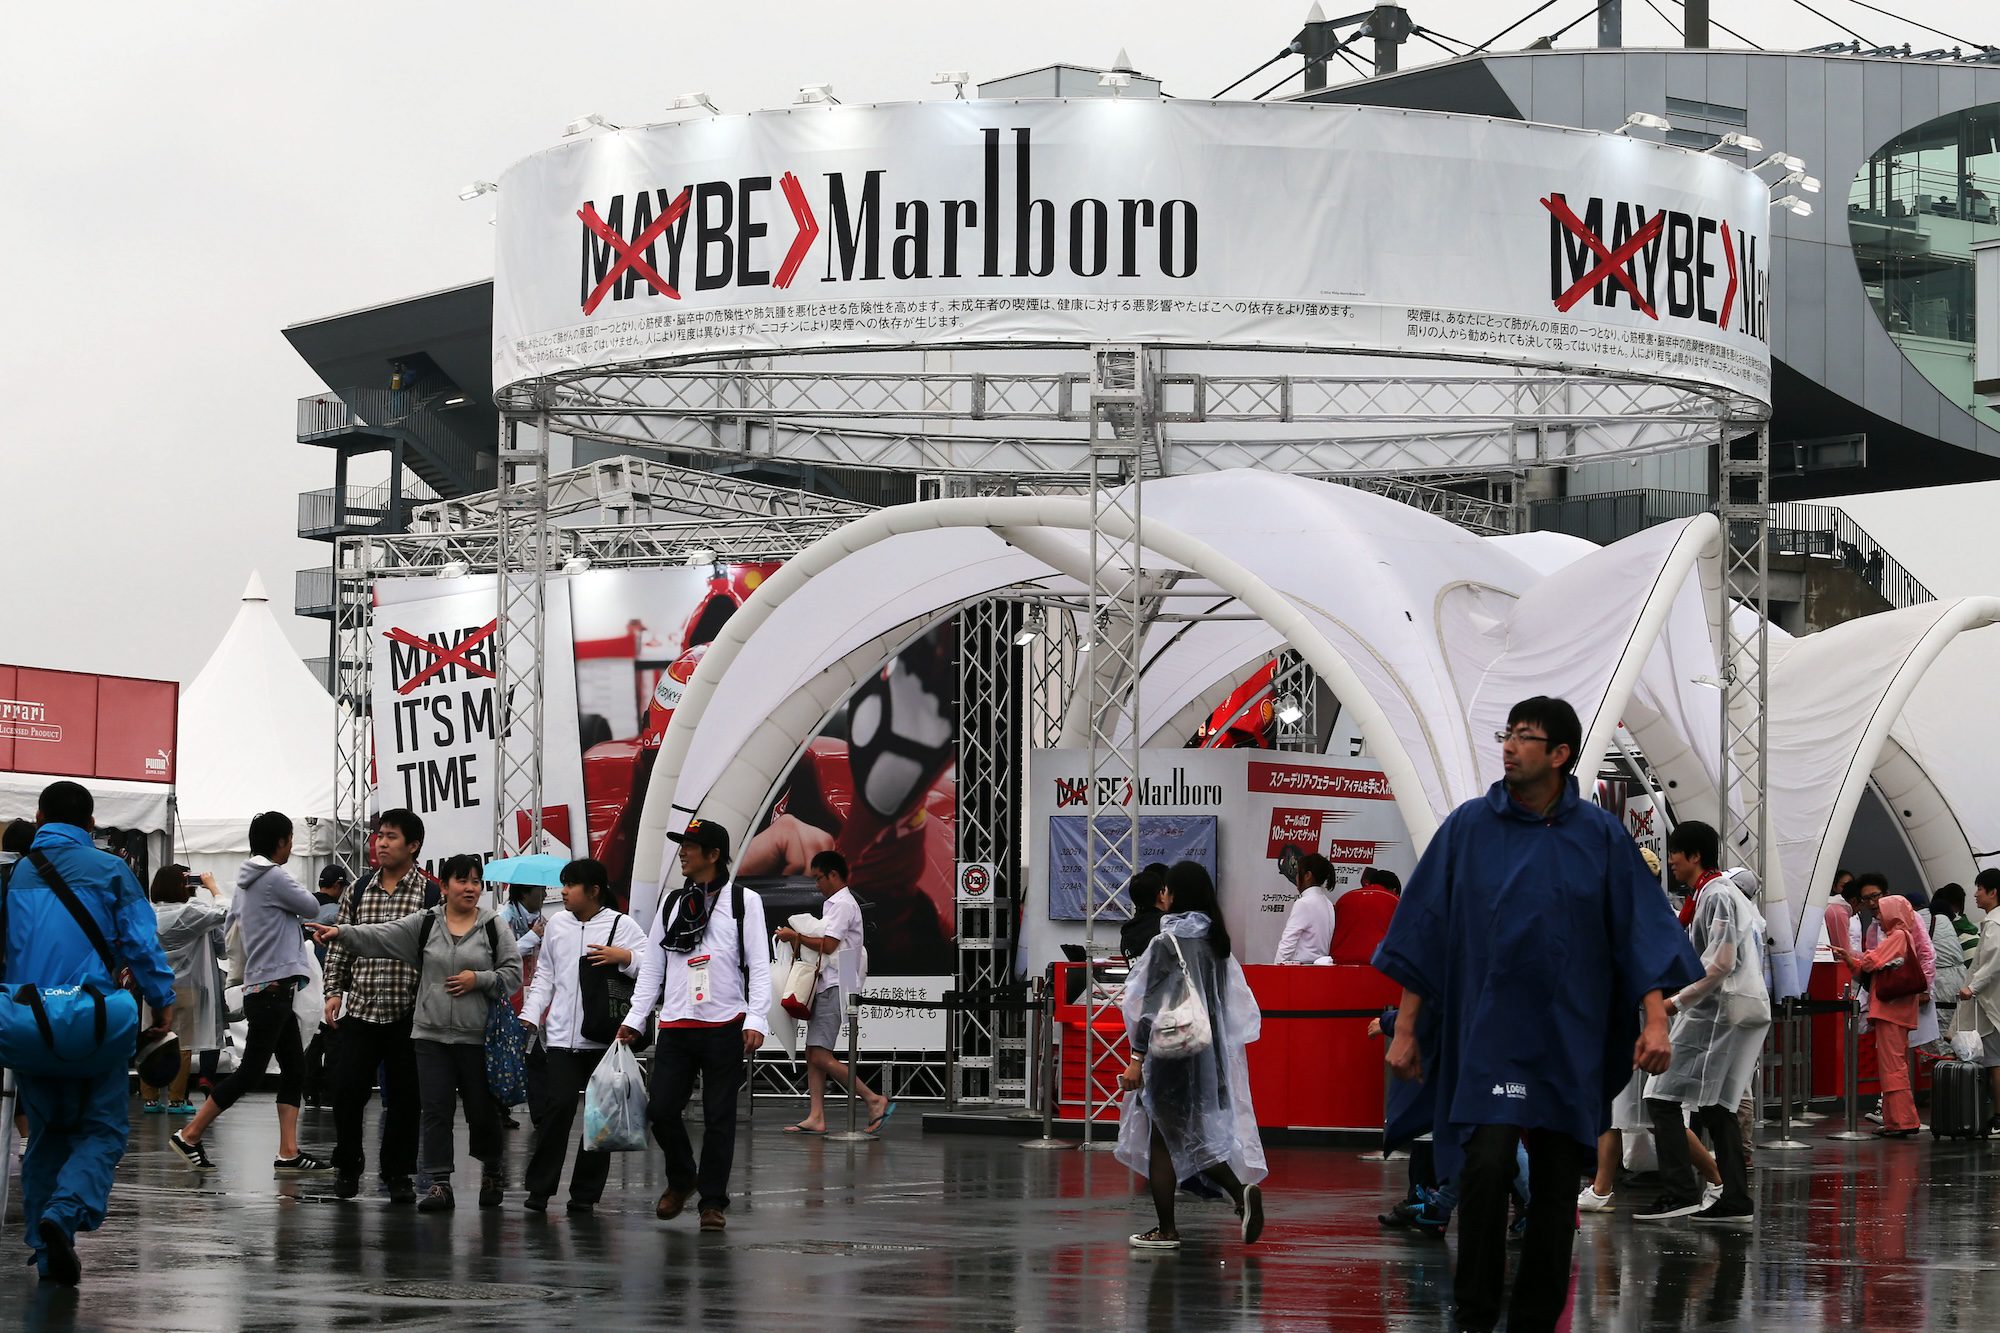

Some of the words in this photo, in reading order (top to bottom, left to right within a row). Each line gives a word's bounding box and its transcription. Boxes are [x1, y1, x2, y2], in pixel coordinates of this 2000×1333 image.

[581, 176, 771, 307] MAYBE
[820, 127, 1198, 282] Marlboro
[1551, 192, 1717, 325] MAYBE
[1738, 229, 1769, 345] Ma
[0, 700, 45, 721] rrari
[394, 694, 454, 753] IT'S
[145, 757, 166, 769] PUMA
[397, 754, 480, 813] TIME
[1056, 778, 1122, 806] MABE
[1138, 767, 1222, 806] Marlboro
